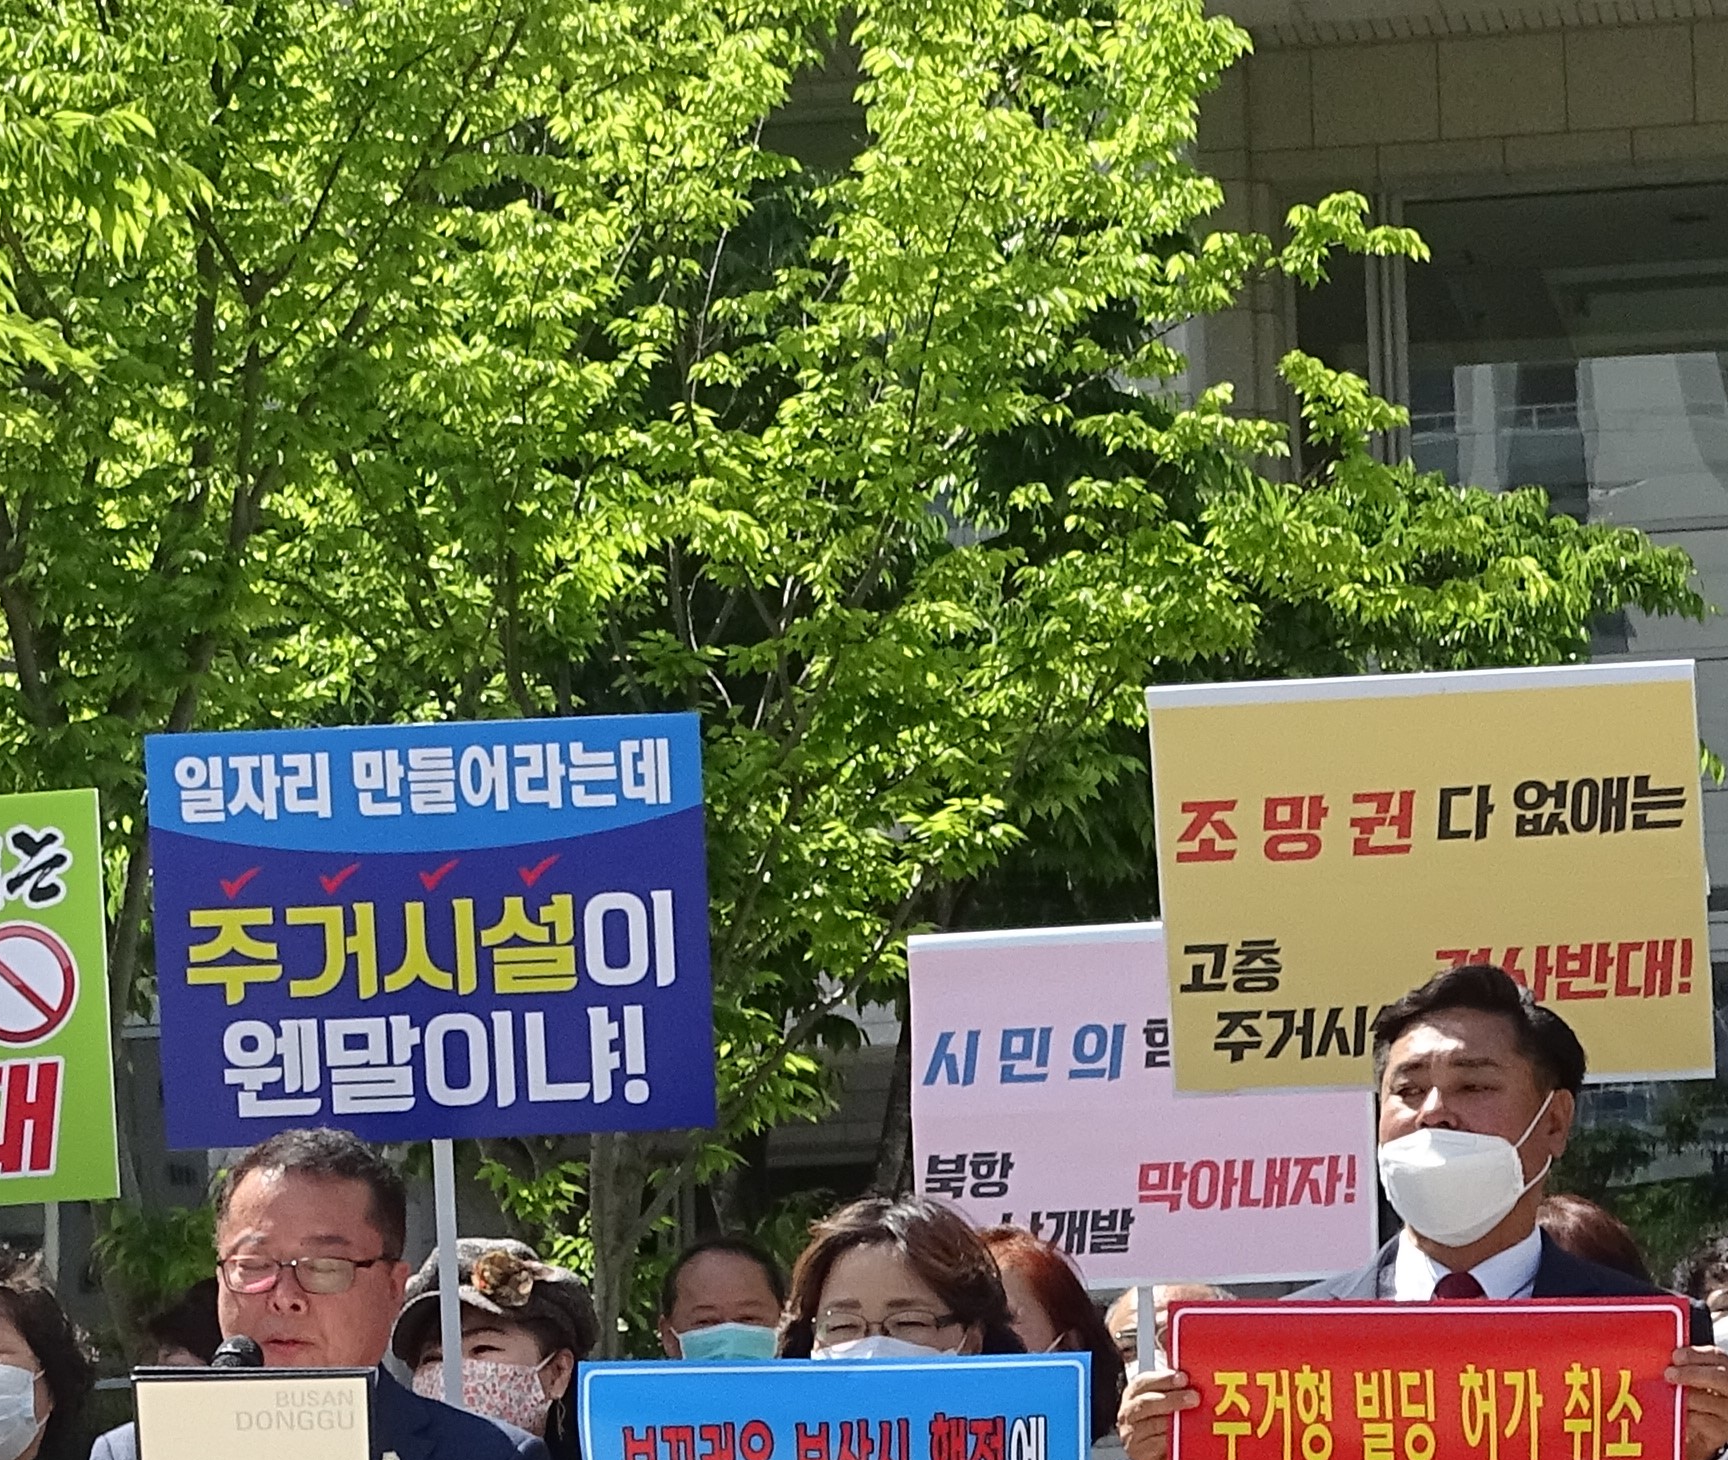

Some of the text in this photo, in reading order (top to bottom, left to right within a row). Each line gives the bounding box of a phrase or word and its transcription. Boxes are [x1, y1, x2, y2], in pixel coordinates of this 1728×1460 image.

[174, 738, 672, 823] 일자리 만들어라는데
[1438, 783, 1495, 841] 다
[1513, 774, 1687, 837] 없애는
[186, 889, 675, 1005] 주거시설이
[1179, 938, 1282, 994] 고층
[223, 1004, 650, 1118] 웬말이냐!
[1214, 1004, 1379, 1063] 주거시
[925, 1151, 1014, 1200] 북항
[1138, 1154, 1356, 1213] 막아내자!
[1000, 1207, 1135, 1256] 개발
[235, 1410, 355, 1431] DONGGU
[275, 1389, 354, 1408] BUSAN
